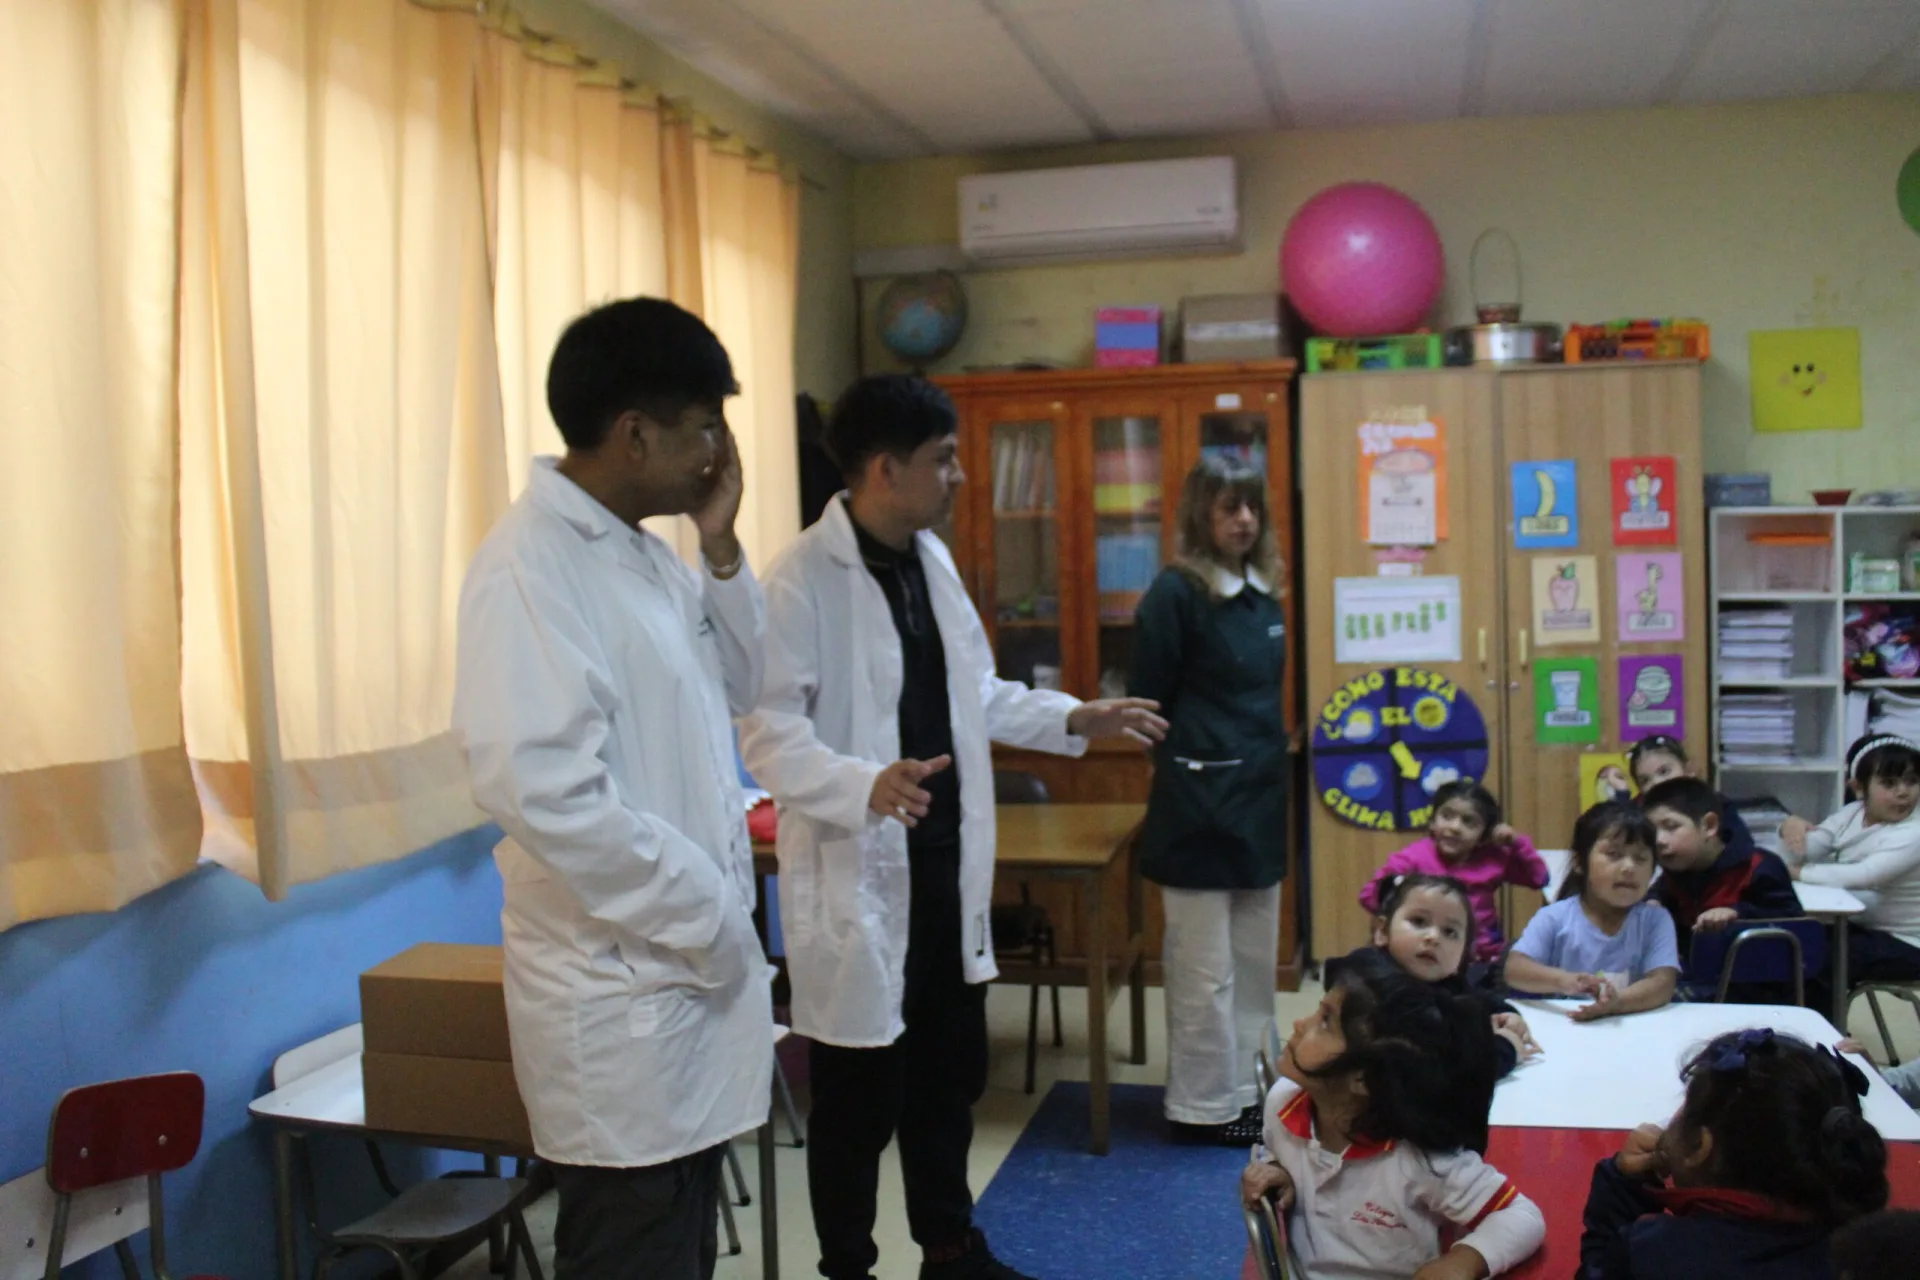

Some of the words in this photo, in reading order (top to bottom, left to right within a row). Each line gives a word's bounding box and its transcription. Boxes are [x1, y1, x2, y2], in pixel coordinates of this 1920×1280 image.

[1396, 667, 1457, 702] ESTA
[1380, 706, 1411, 726] EL
[1324, 787, 1395, 831] CLIMA
